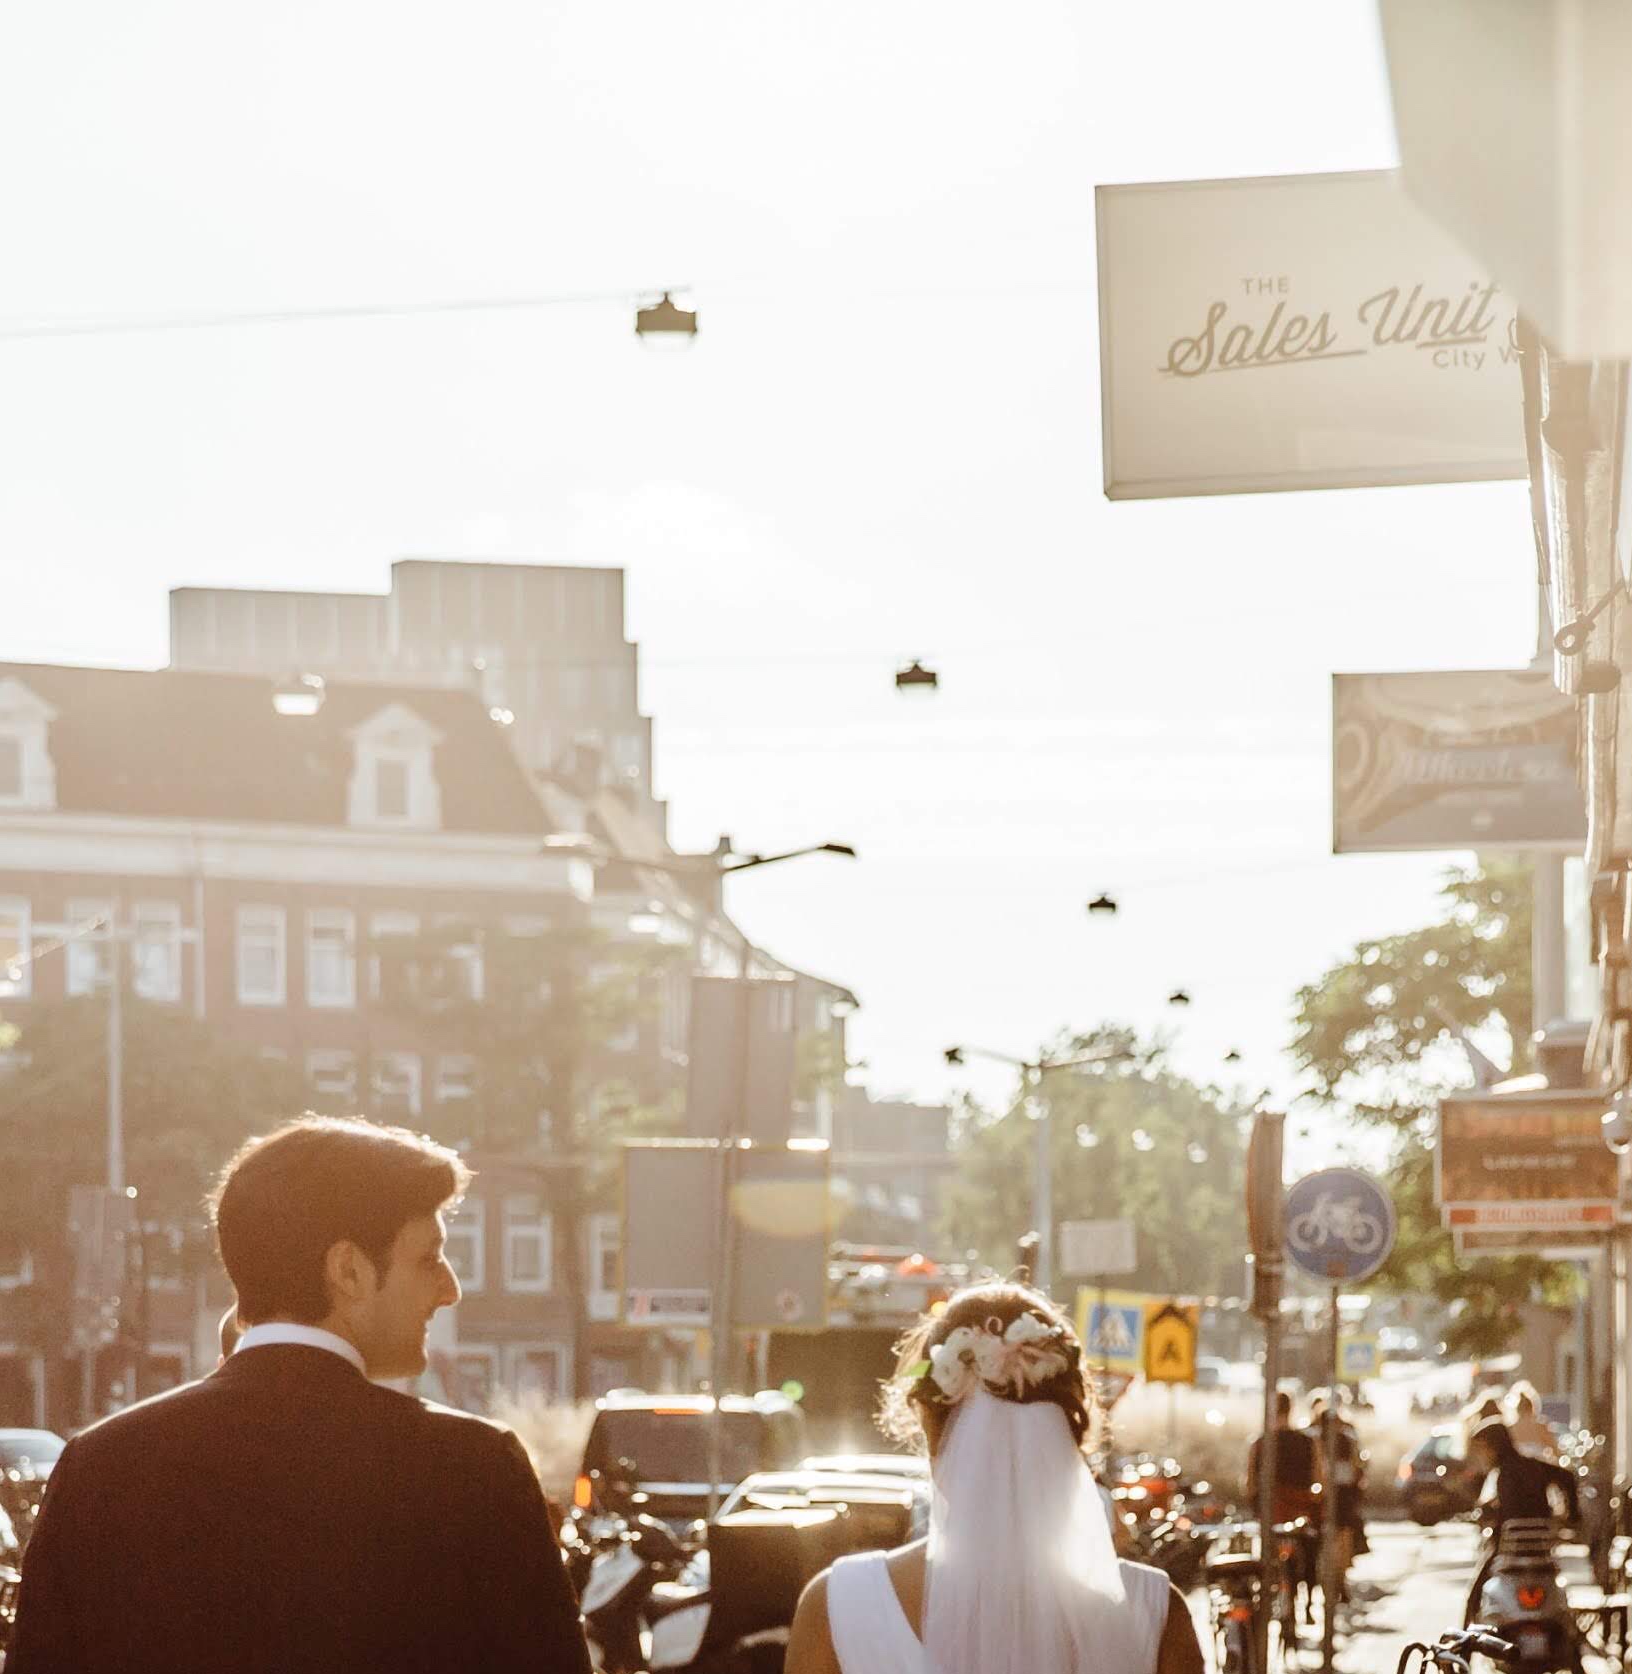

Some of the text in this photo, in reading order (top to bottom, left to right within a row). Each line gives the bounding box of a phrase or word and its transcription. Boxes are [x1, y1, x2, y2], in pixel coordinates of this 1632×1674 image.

[1241, 277, 1290, 295] THE
[1157, 282, 1500, 377] Sales Unit
